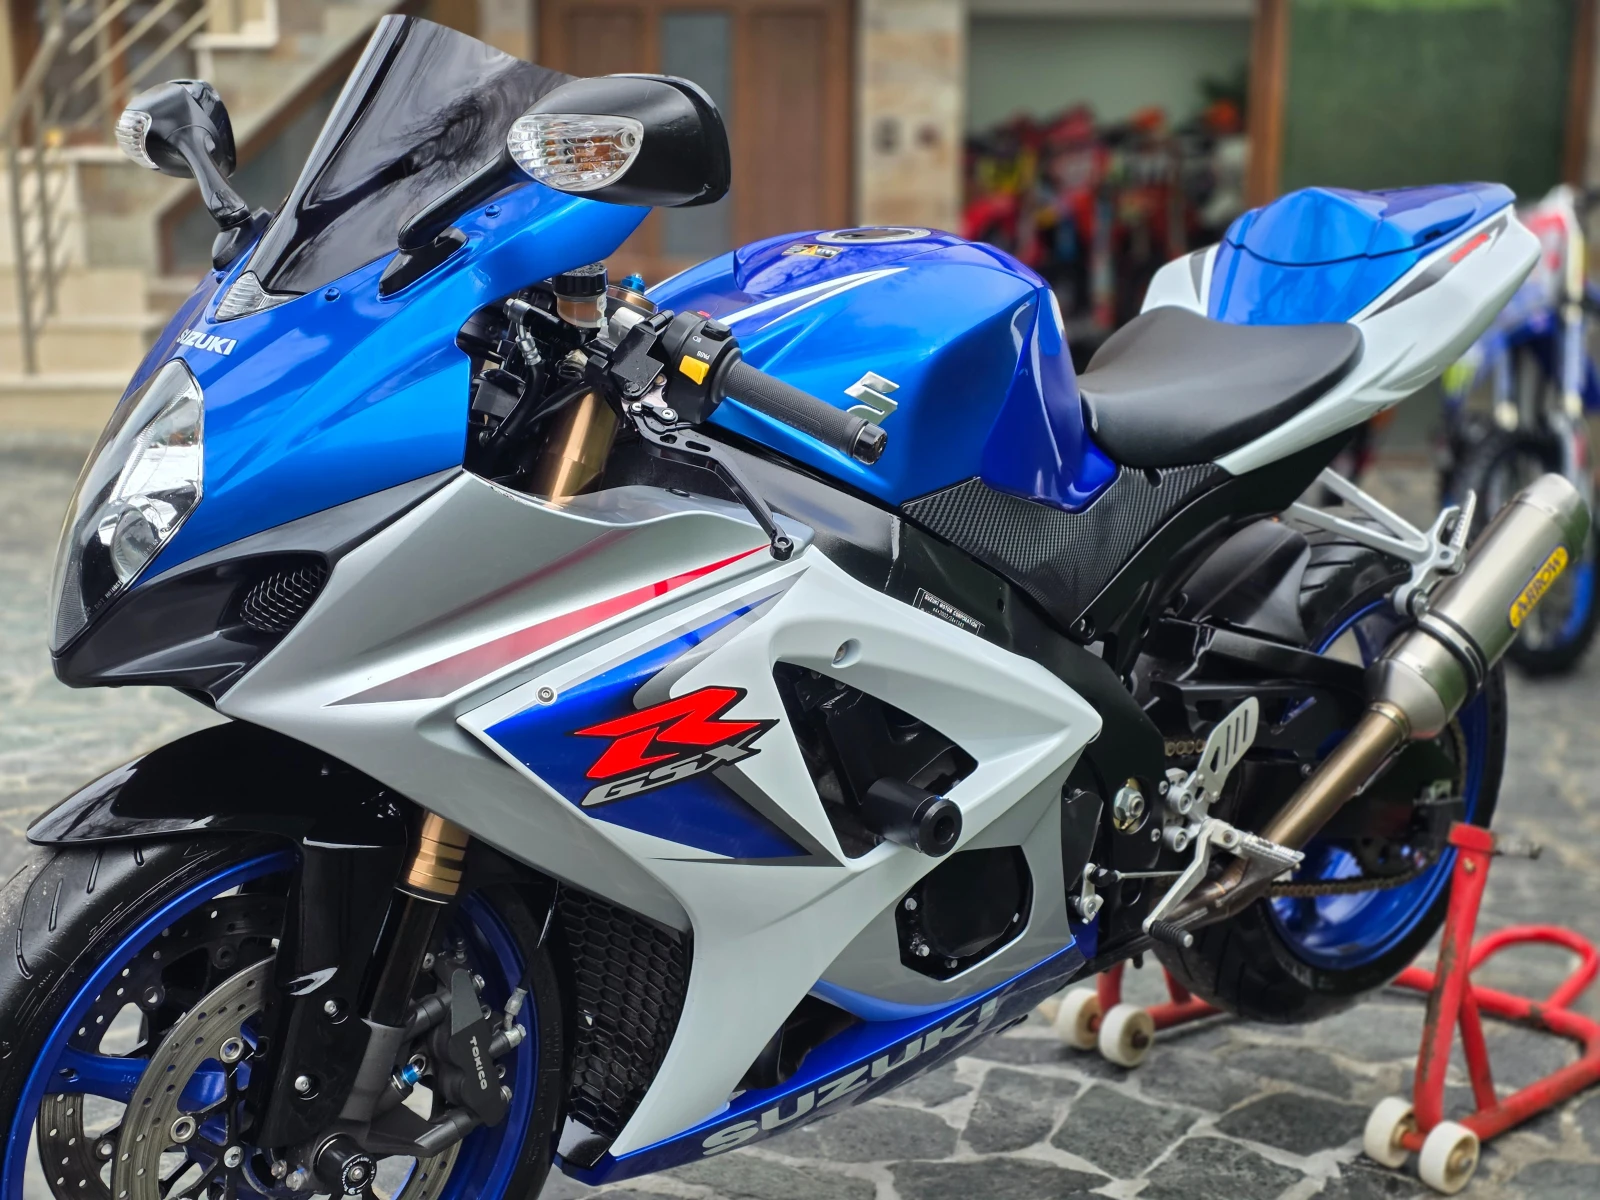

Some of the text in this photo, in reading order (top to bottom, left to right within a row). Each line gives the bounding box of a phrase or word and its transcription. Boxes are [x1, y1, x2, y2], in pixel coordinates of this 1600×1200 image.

[697, 350, 711, 360] PASS
[939, 602, 954, 614] MOTOR
[952, 610, 979, 629] CORPORATION
[1514, 553, 1564, 620] ARROW
[581, 730, 762, 806] GSX
[470, 1035, 488, 1091] TOKICO
[702, 996, 999, 1156] SUZUKI
